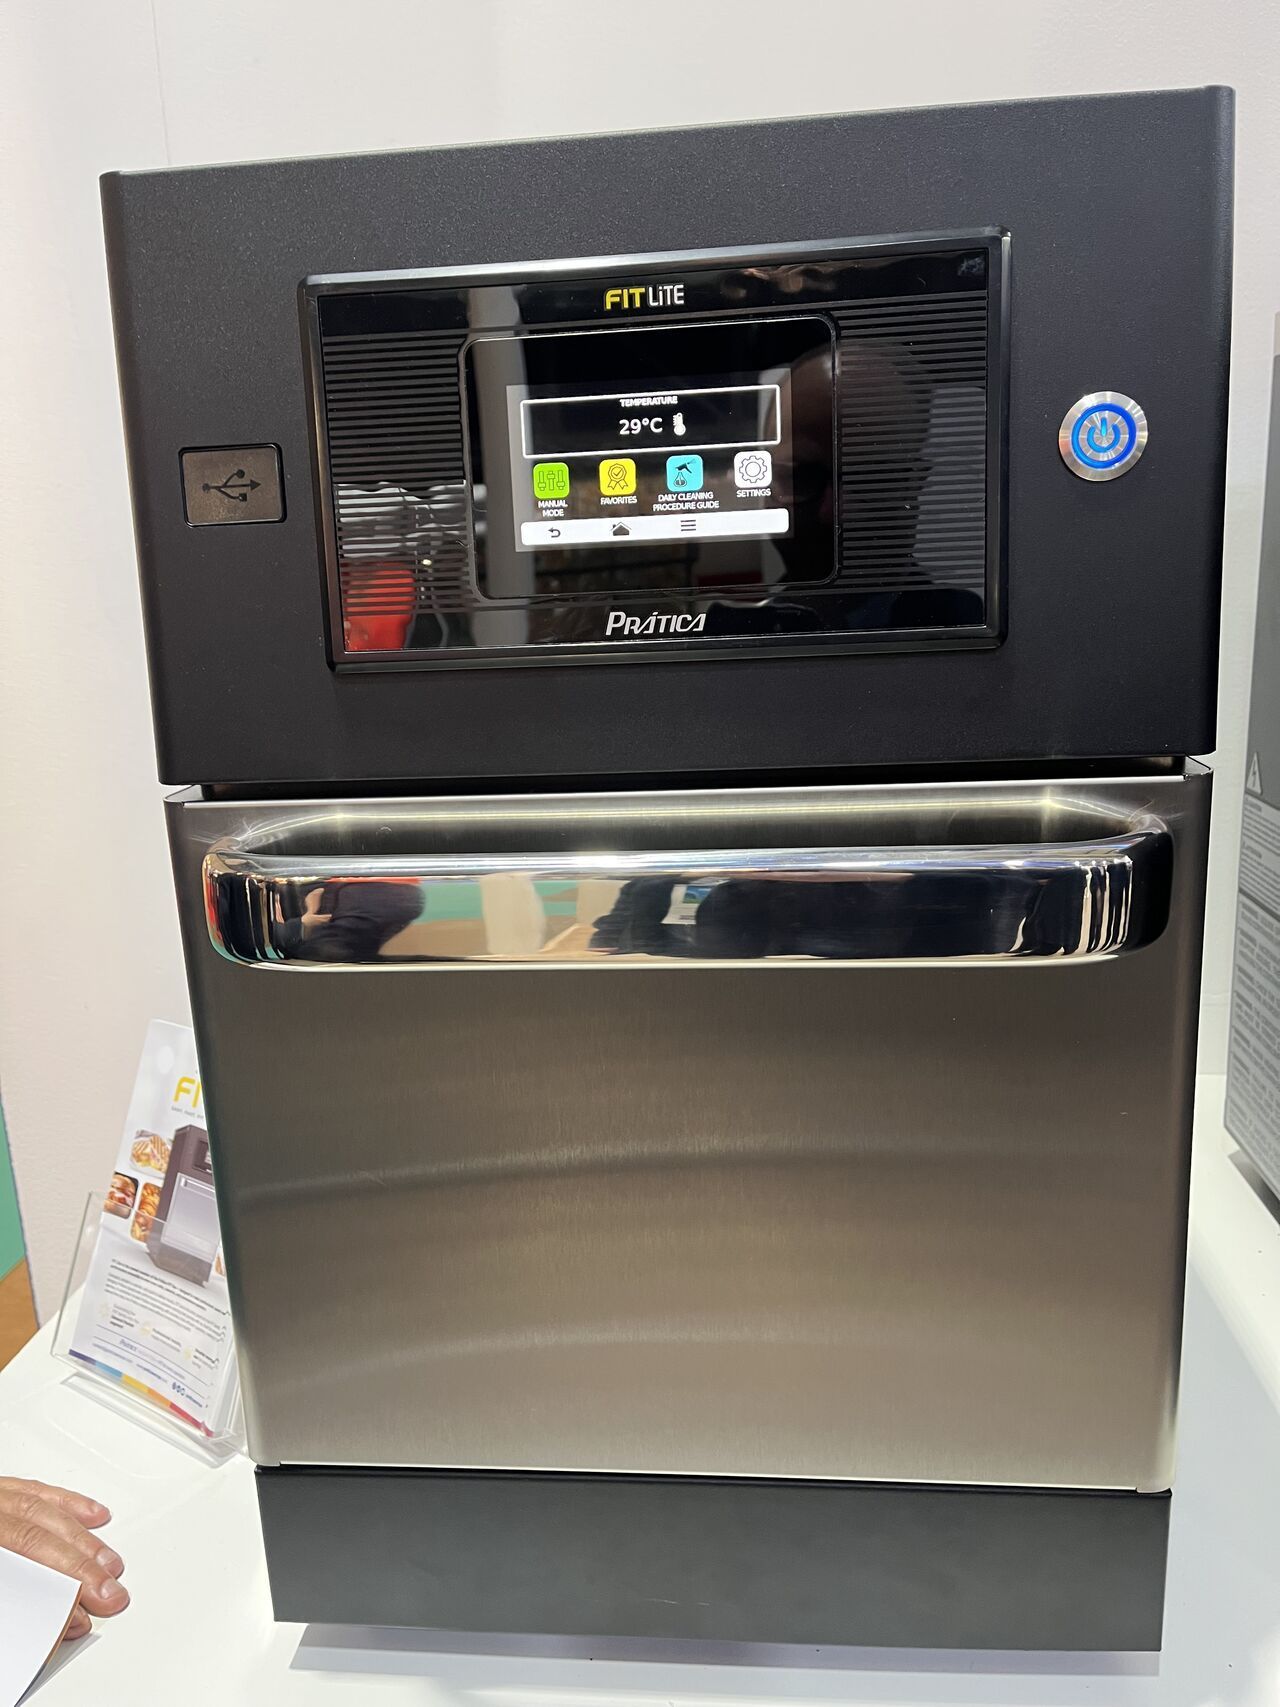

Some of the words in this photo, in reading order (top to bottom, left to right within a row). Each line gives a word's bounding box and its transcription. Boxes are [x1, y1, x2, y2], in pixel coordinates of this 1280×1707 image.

[605, 287, 646, 310] FIT
[619, 395, 678, 407] TEMPERATURE
[619, 417, 663, 435] 29°C
[658, 493, 677, 502] DAILY
[678, 491, 714, 500] CLEANING
[736, 488, 772, 498] SETTINGS
[538, 499, 569, 509] MANUAL
[600, 495, 638, 506] FAVORITES
[652, 502, 696, 512] PROCEDURE
[696, 500, 720, 509] GUIDE
[542, 508, 565, 517] MODE
